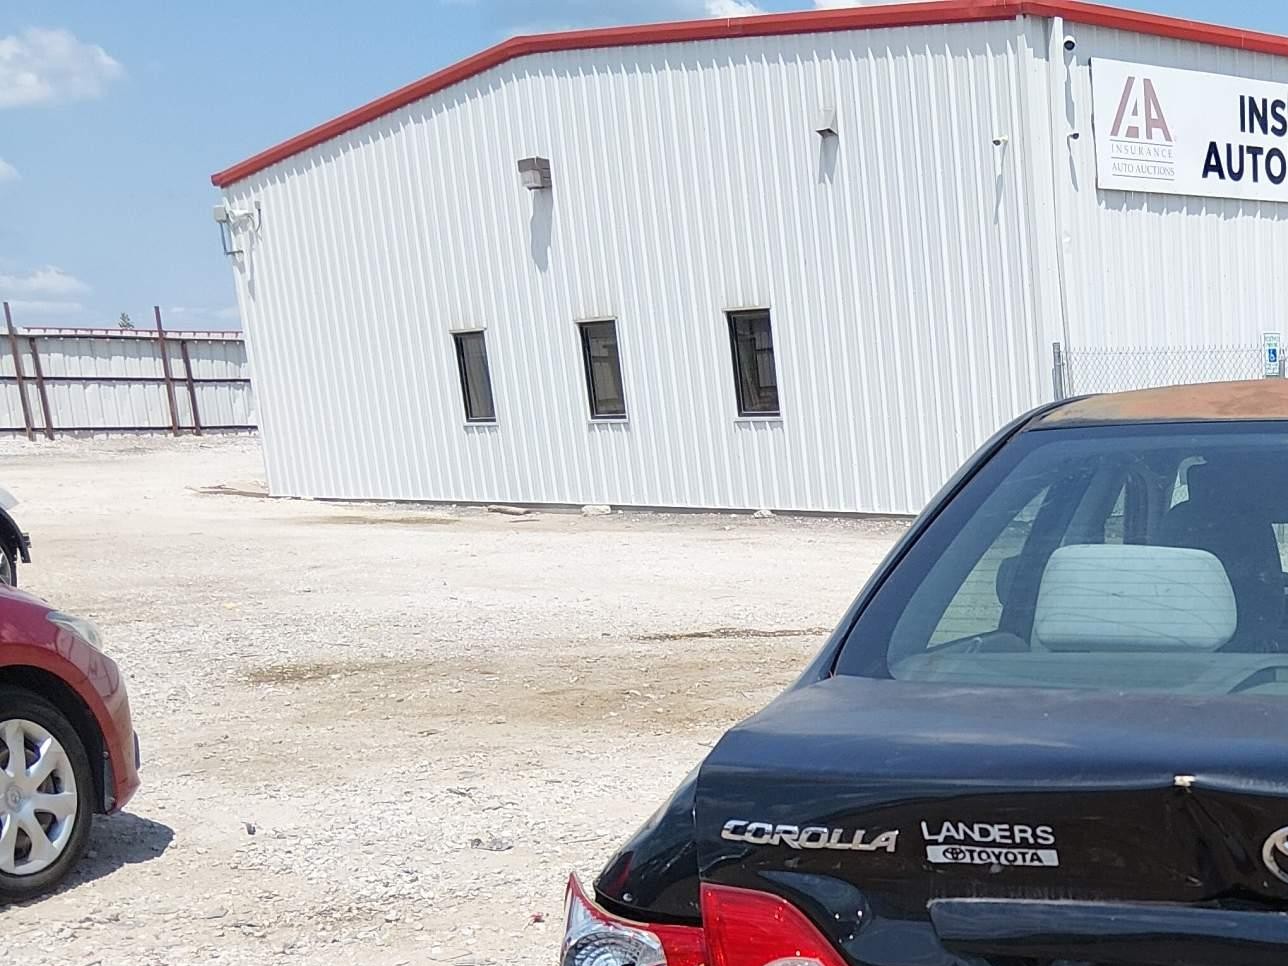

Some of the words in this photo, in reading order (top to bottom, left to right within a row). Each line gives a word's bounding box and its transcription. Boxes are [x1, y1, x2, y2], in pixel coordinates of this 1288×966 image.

[1111, 143, 1173, 159] INSURANCE
[1112, 162, 1134, 173] AUTO
[1135, 164, 1175, 177] AUCTIONS
[1201, 141, 1287, 185] AUTO
[721, 819, 899, 852] COROLLA
[921, 820, 1055, 845] LANDERS
[967, 848, 1044, 864] TOYOTA
